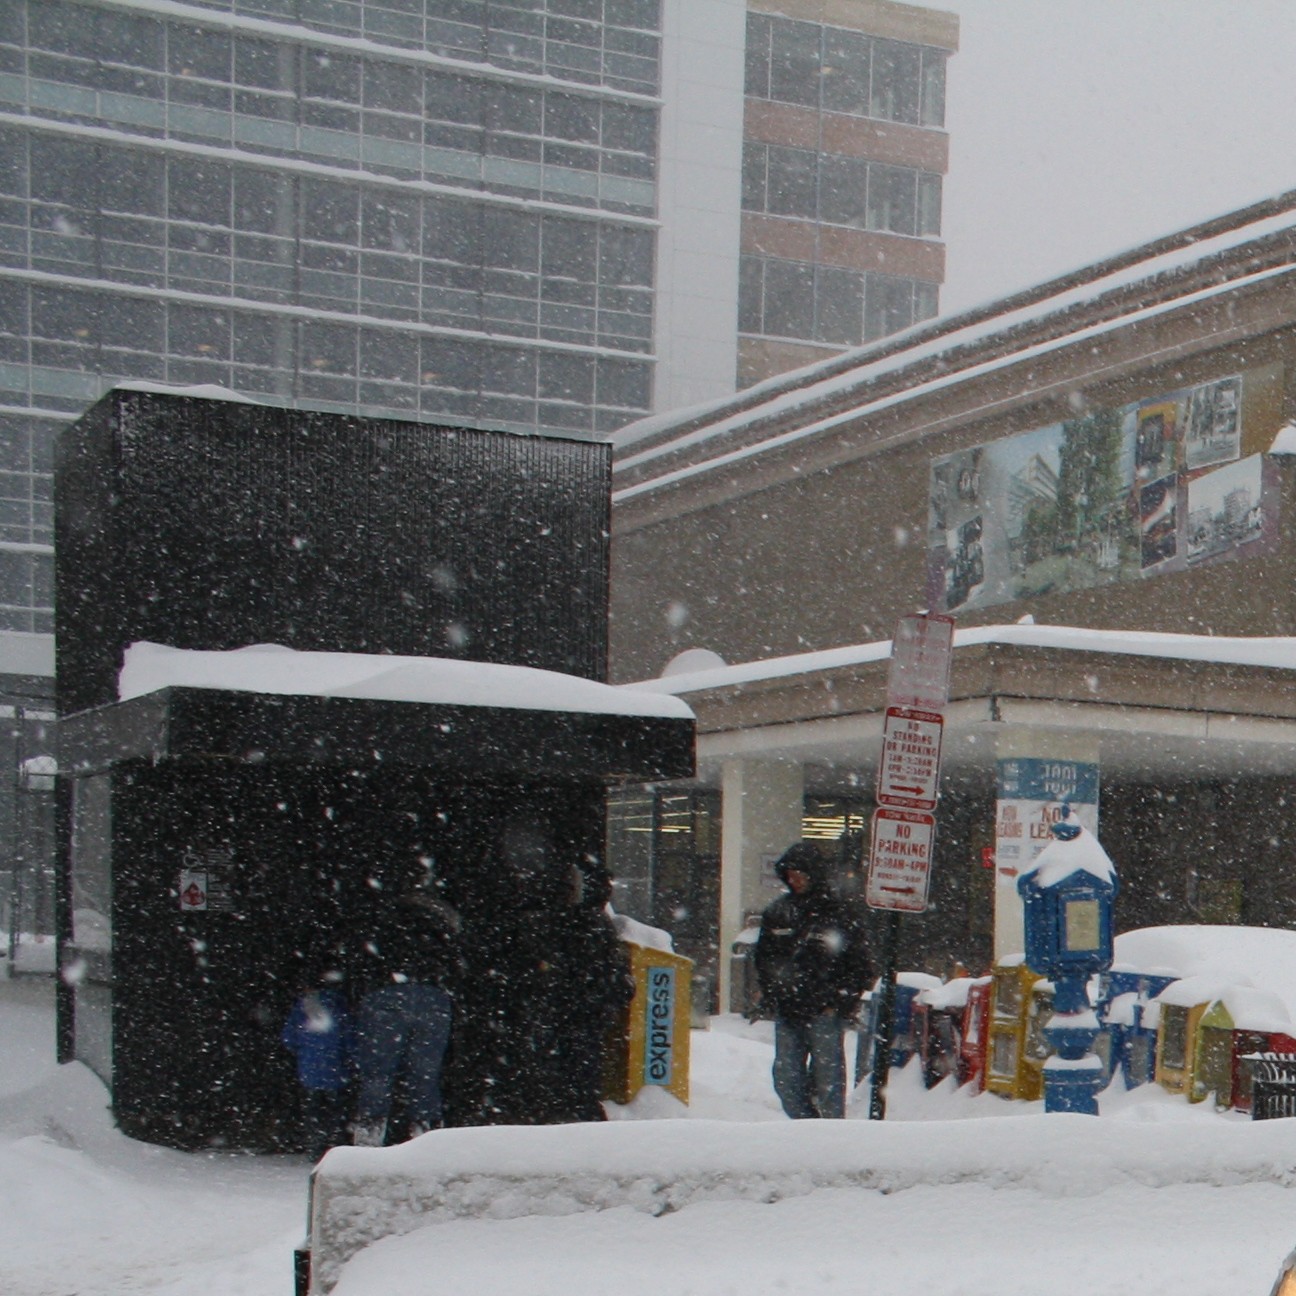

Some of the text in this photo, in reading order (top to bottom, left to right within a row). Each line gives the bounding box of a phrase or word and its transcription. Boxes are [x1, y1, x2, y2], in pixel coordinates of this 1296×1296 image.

[893, 730, 933, 746] STANDING
[901, 743, 937, 757] PARKING
[896, 824, 912, 840] NO
[878, 839, 927, 858] PARKING
[650, 972, 671, 1081] express
